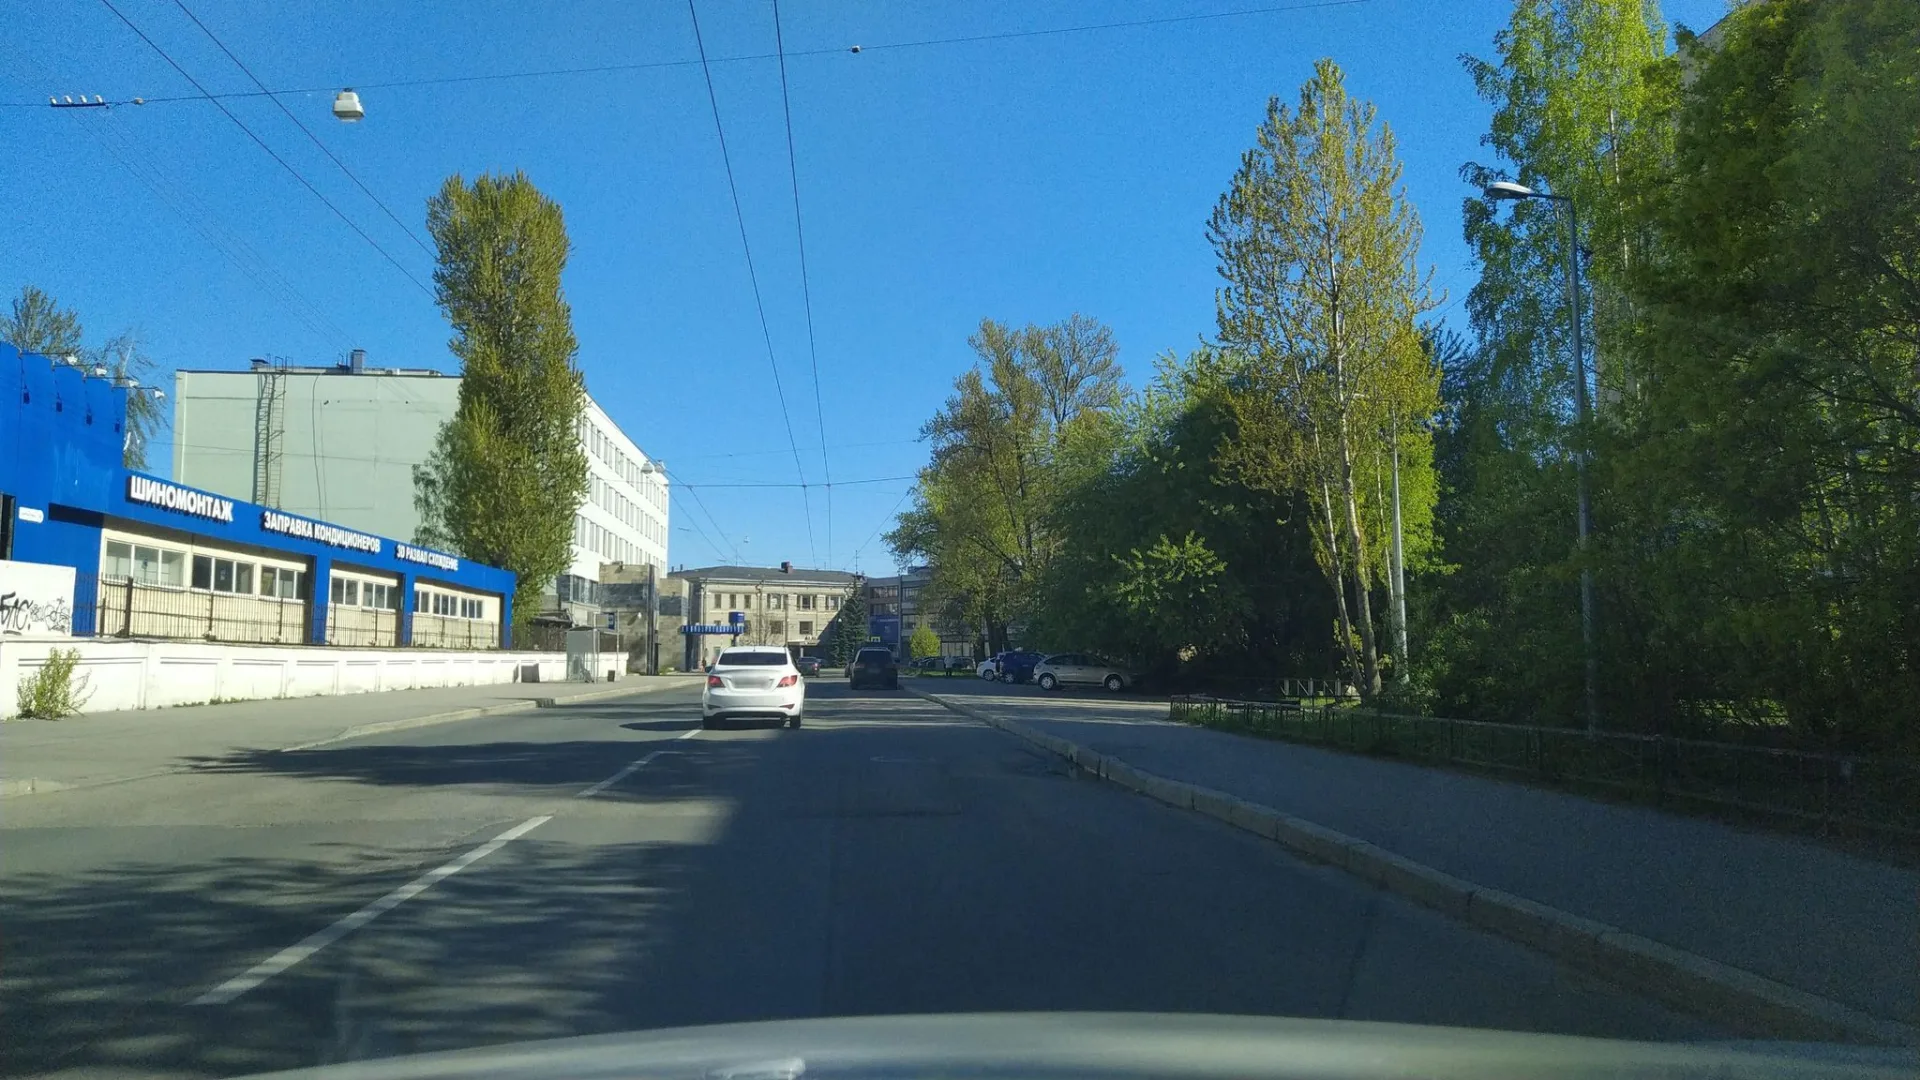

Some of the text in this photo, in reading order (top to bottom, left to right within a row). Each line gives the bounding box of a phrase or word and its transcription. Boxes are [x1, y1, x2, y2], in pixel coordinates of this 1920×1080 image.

[130, 475, 234, 522] ШИНОМОНТАЖ
[264, 511, 381, 553] ЗАПРАВКА КОНДИЦИОНЕРОВ
[406, 546, 428, 563] РАЗВАЛ
